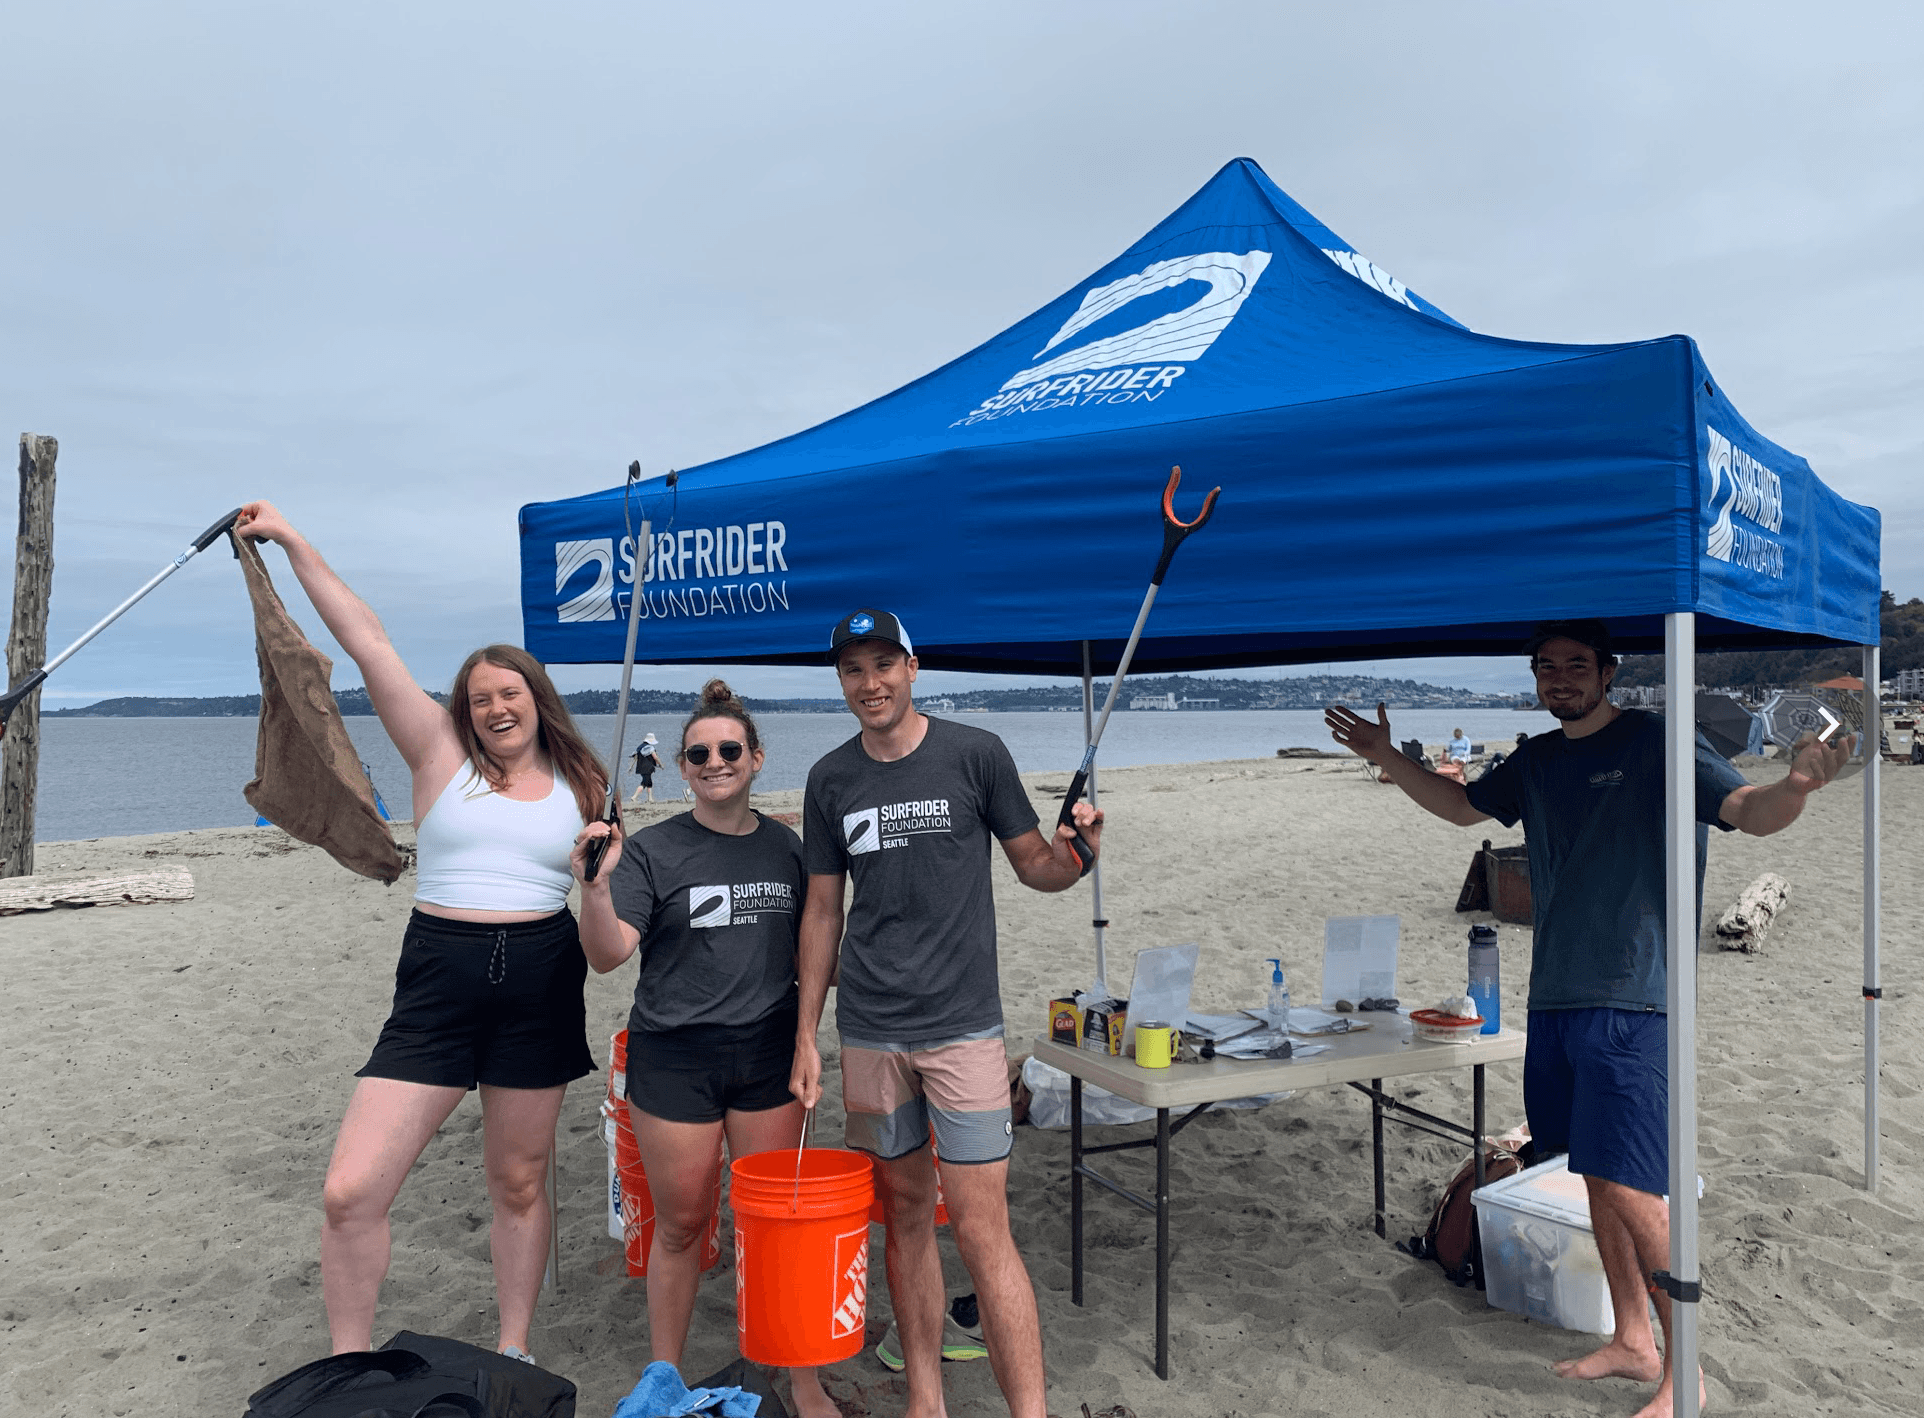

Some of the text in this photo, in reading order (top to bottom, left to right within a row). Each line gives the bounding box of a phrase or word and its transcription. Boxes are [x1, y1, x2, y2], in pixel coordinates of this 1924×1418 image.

[969, 366, 1186, 416] SURFRIDER
[948, 390, 1165, 429] FOUNDATION
[618, 521, 789, 584] SURFRIDER
[881, 799, 950, 822] SURFRIDER
[881, 816, 951, 833] FOUNDATION
[882, 838, 909, 849] SEATTLE
[733, 882, 792, 899] SURFRIDER
[733, 897, 794, 910] FOUNDATION
[732, 915, 758, 925] SEATTLE
